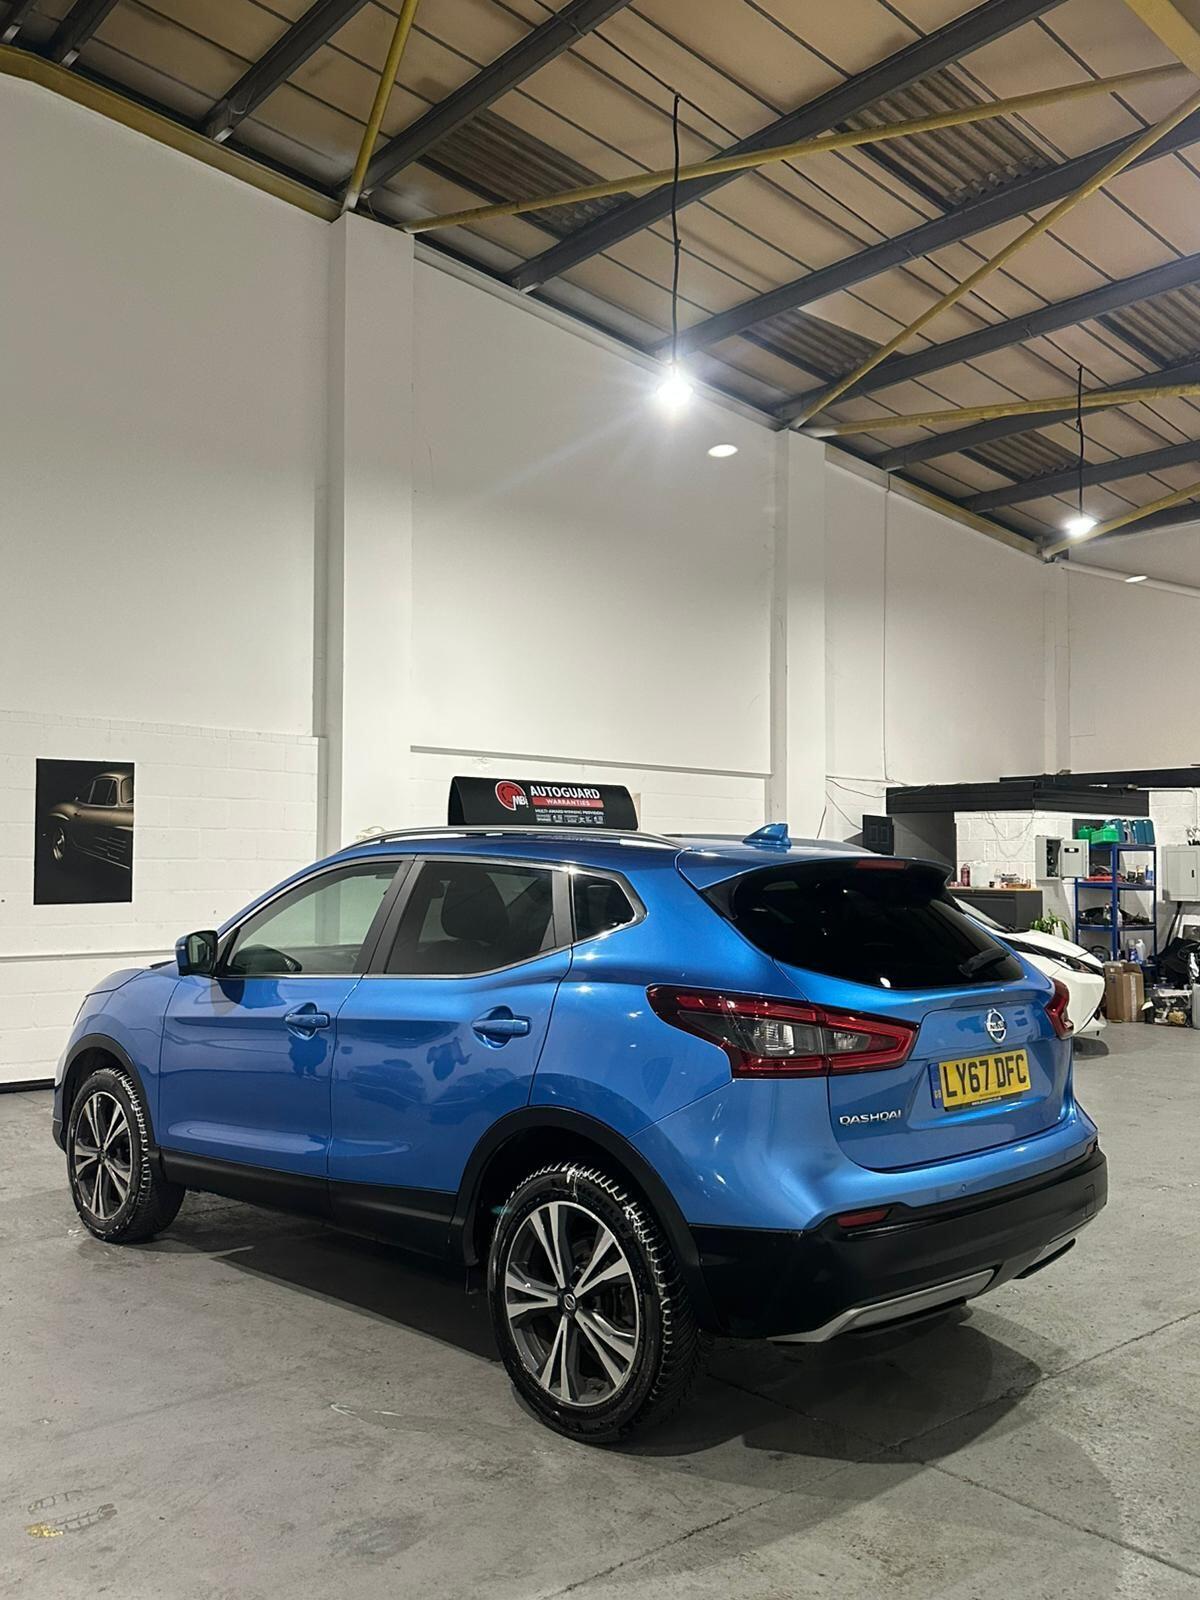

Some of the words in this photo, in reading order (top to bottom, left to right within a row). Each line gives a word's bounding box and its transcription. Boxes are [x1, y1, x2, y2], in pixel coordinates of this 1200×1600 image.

[530, 785, 600, 799] AUTOGUARD
[546, 798, 591, 807] WARRANTIES
[943, 1060, 988, 1098] LY67
[994, 1054, 1027, 1088] DFC
[839, 1109, 902, 1126] QASHQAI
